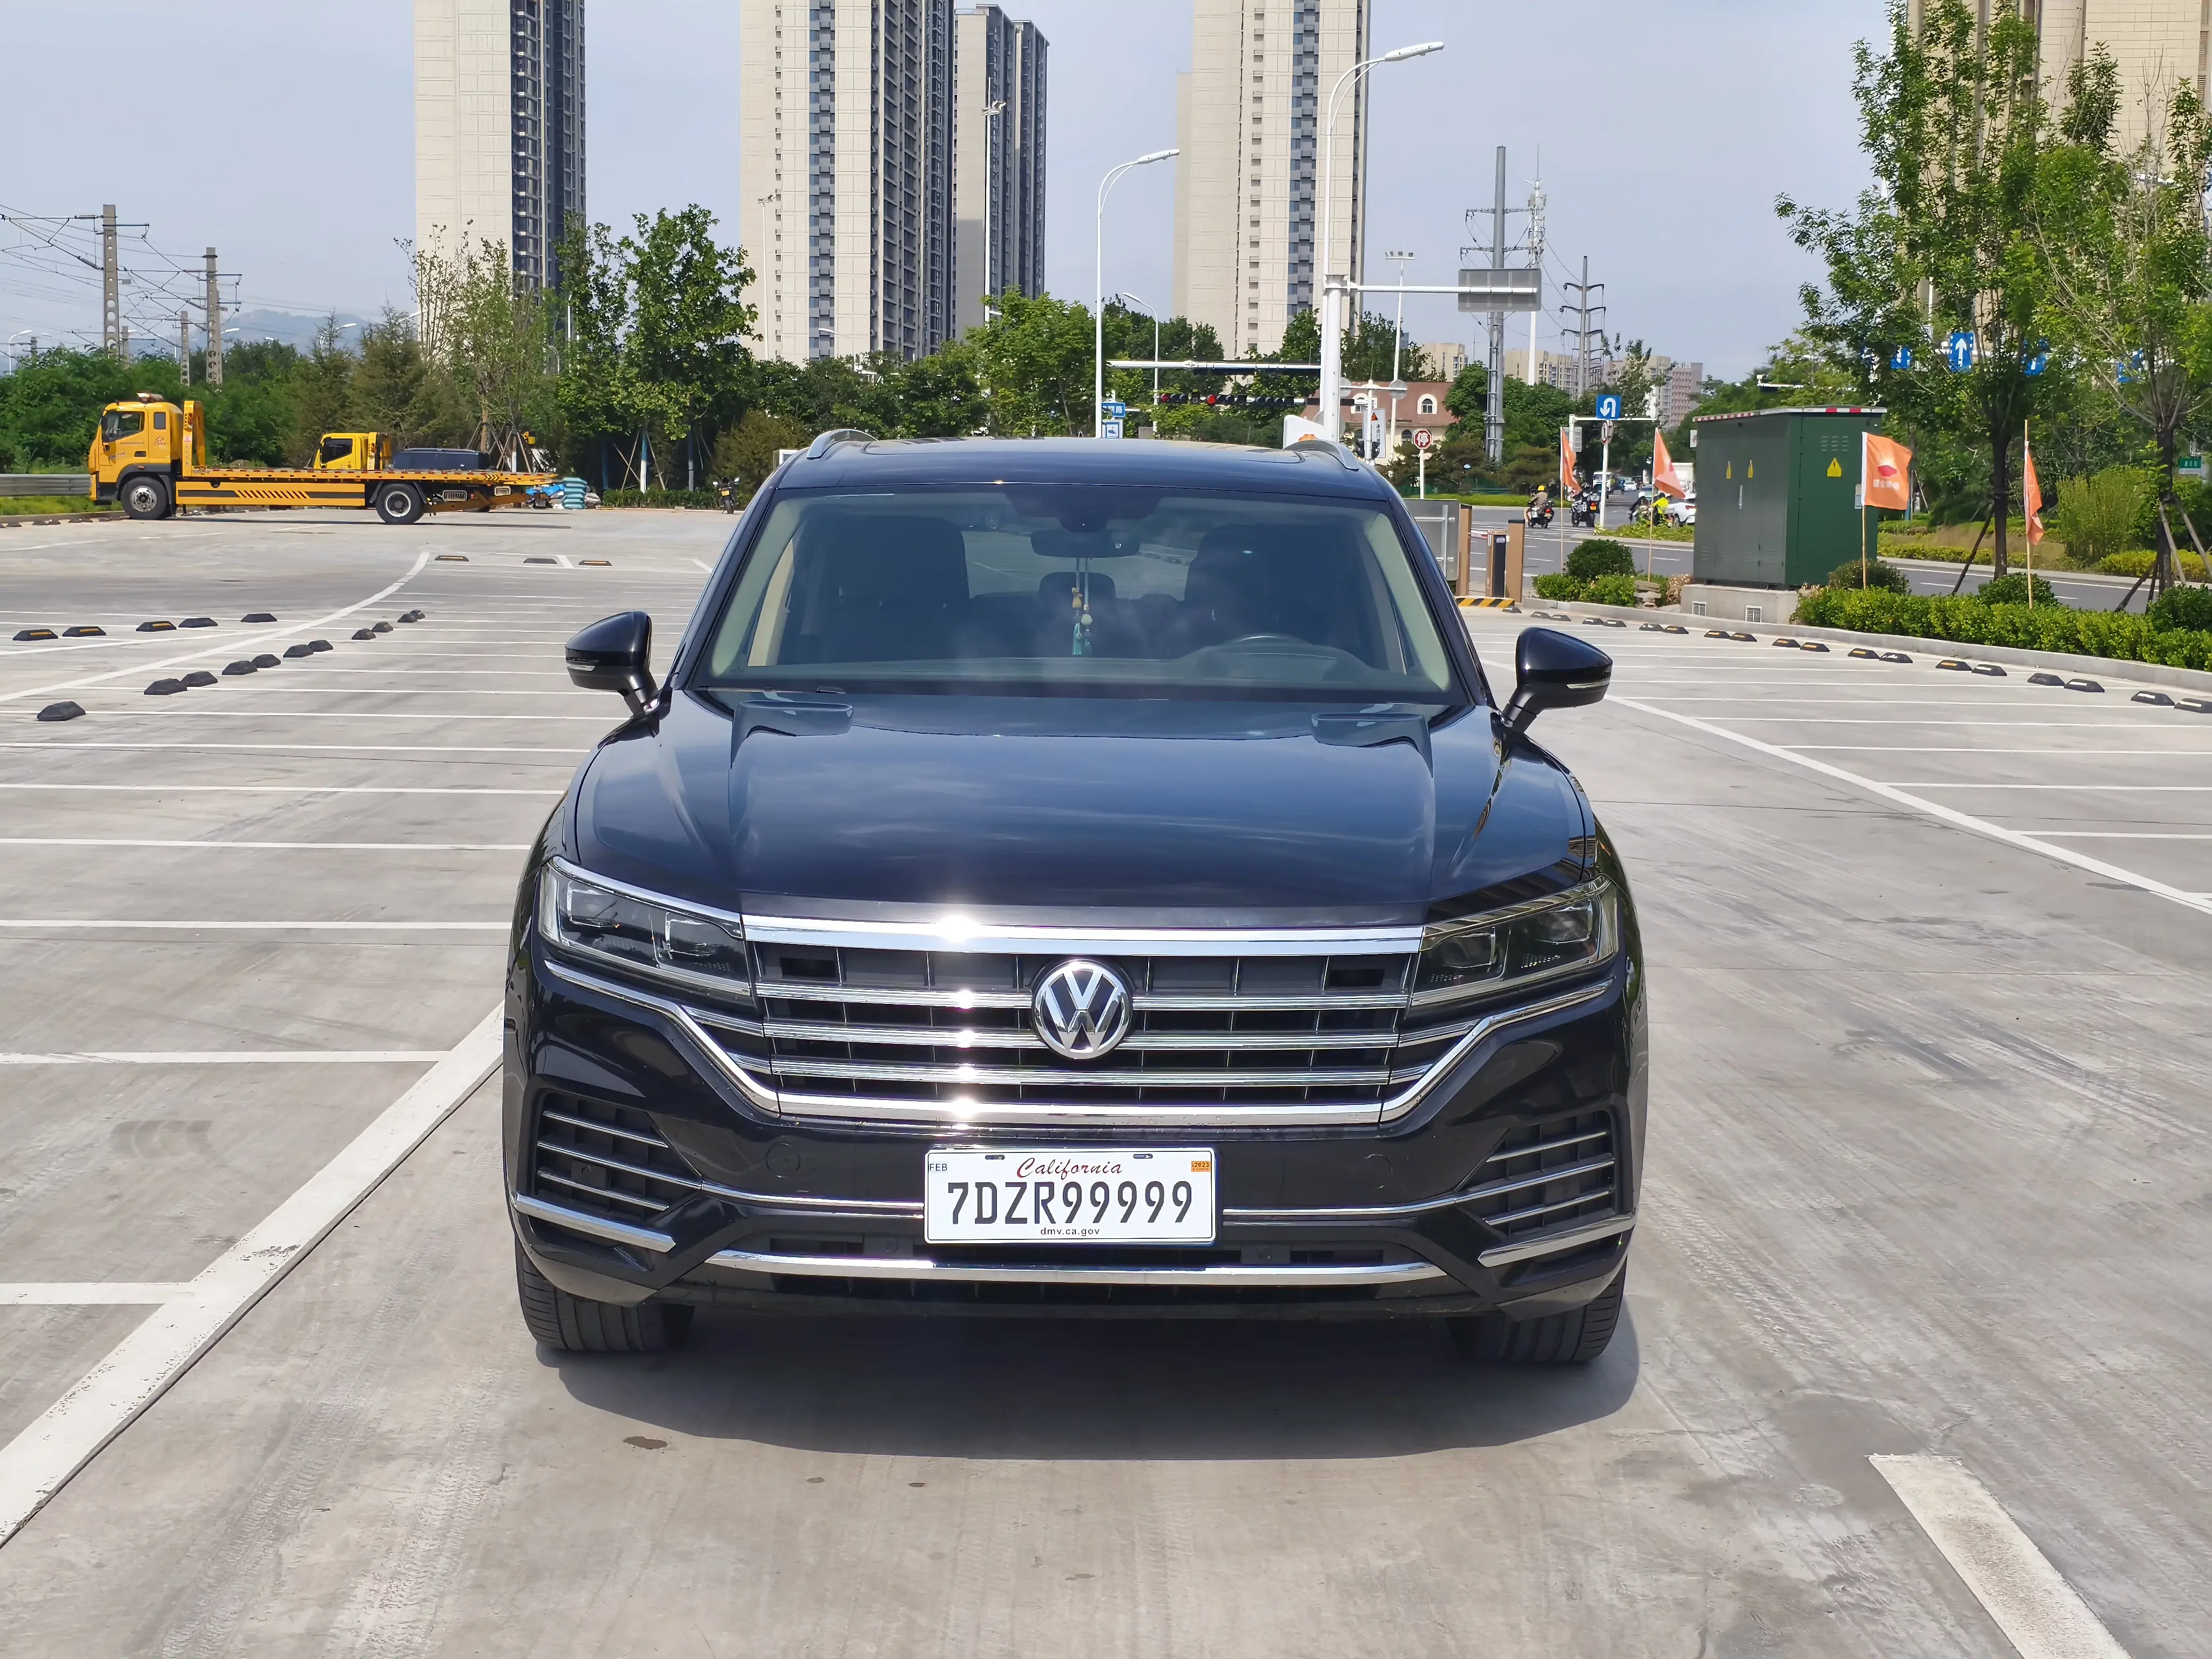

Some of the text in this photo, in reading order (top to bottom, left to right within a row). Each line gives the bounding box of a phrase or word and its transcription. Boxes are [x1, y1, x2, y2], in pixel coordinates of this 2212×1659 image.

[1417, 432, 1429, 446] 停
[929, 1163, 948, 1171] FEB
[1017, 1157, 1123, 1180] California
[948, 1181, 1192, 1225] 7DZR99999
[1040, 1227, 1100, 1237] dmv.ca.gov
